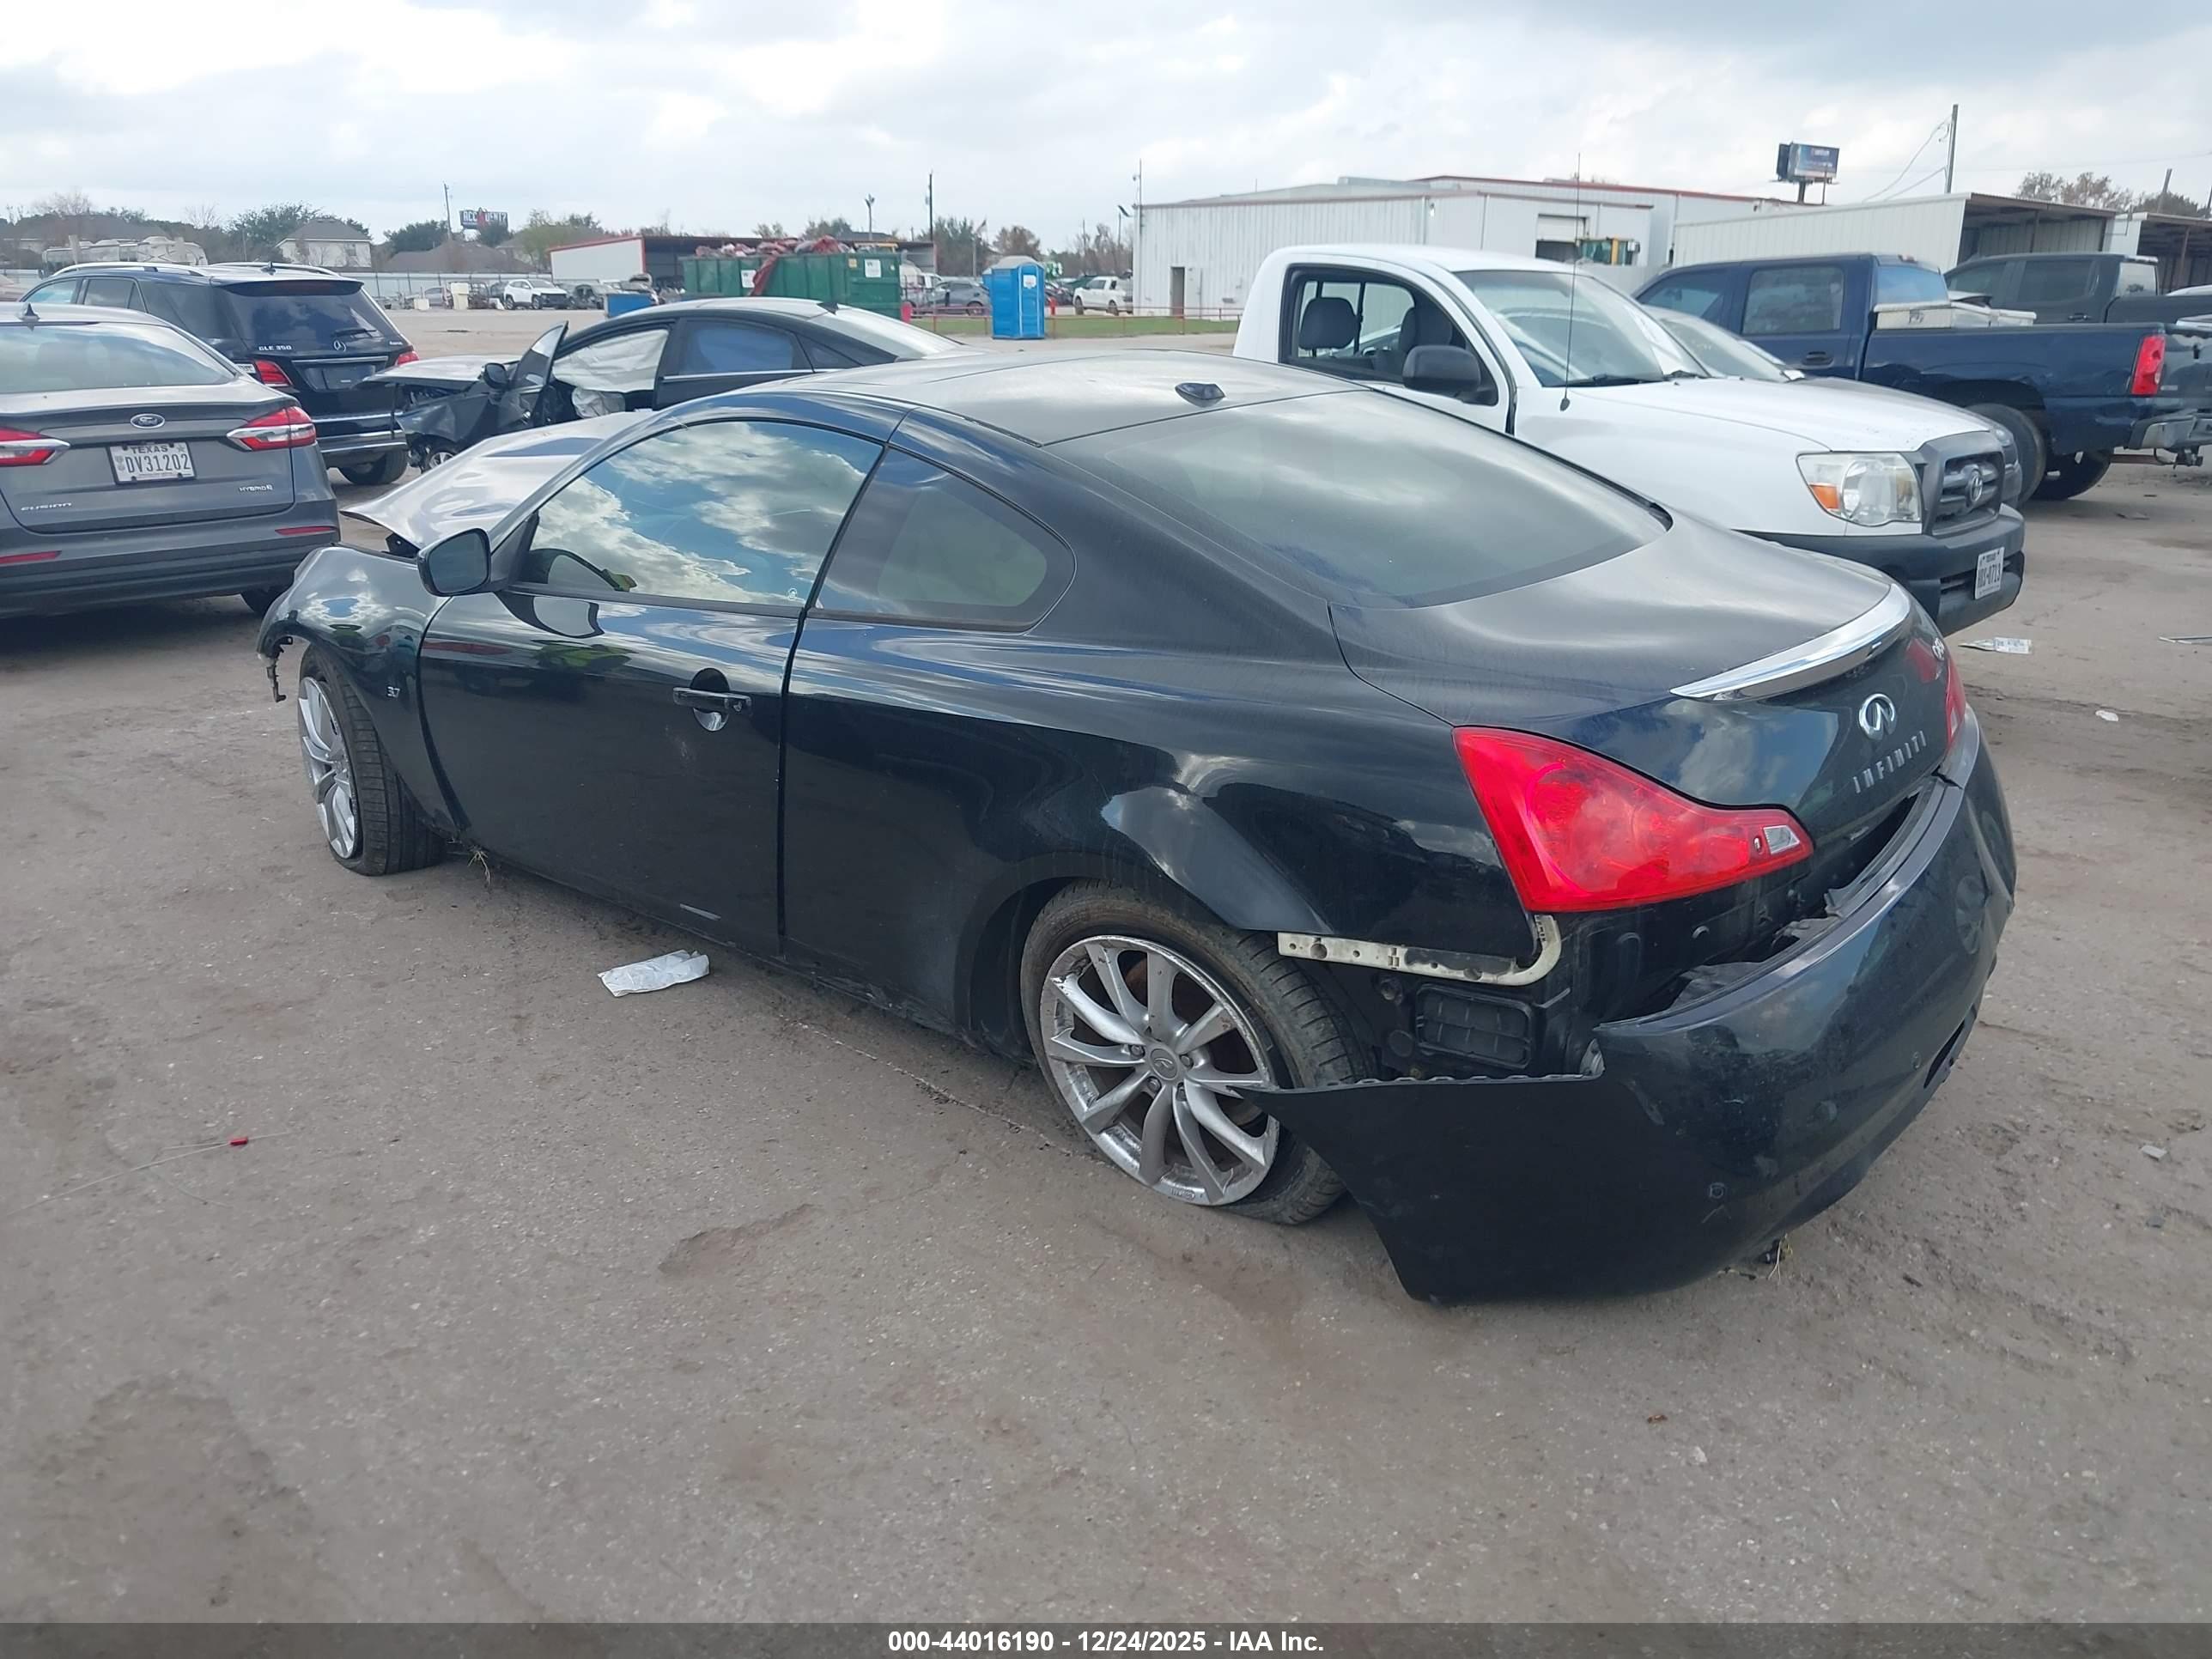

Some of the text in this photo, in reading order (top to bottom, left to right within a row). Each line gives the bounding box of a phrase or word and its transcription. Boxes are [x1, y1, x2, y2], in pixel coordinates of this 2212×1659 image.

[130, 445, 168, 454] TEXAS
[125, 453, 191, 473] DV31202
[1852, 730, 1927, 794] INFINITI
